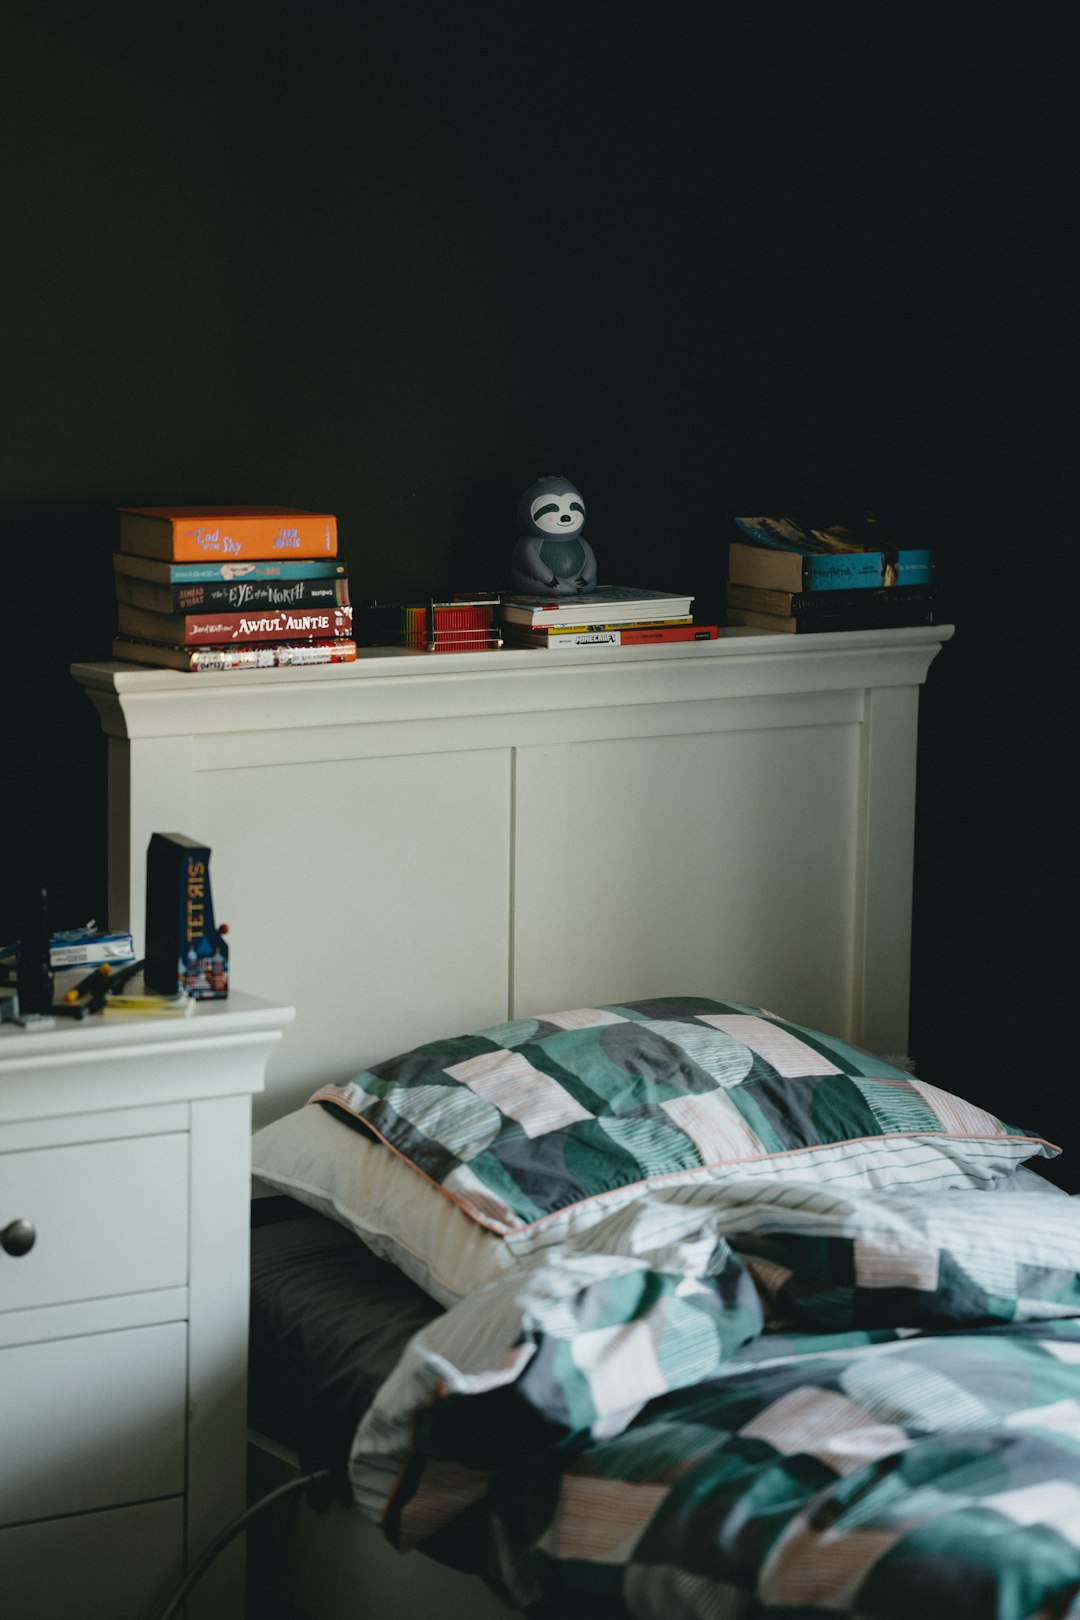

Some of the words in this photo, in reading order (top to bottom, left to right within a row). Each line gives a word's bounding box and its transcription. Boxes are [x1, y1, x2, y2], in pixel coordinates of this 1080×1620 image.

[195, 527, 219, 544] End
[222, 536, 241, 556] Sky
[228, 583, 254, 608] EYE
[267, 582, 305, 605] NORTH
[575, 634, 616, 645] MINECRAFT
